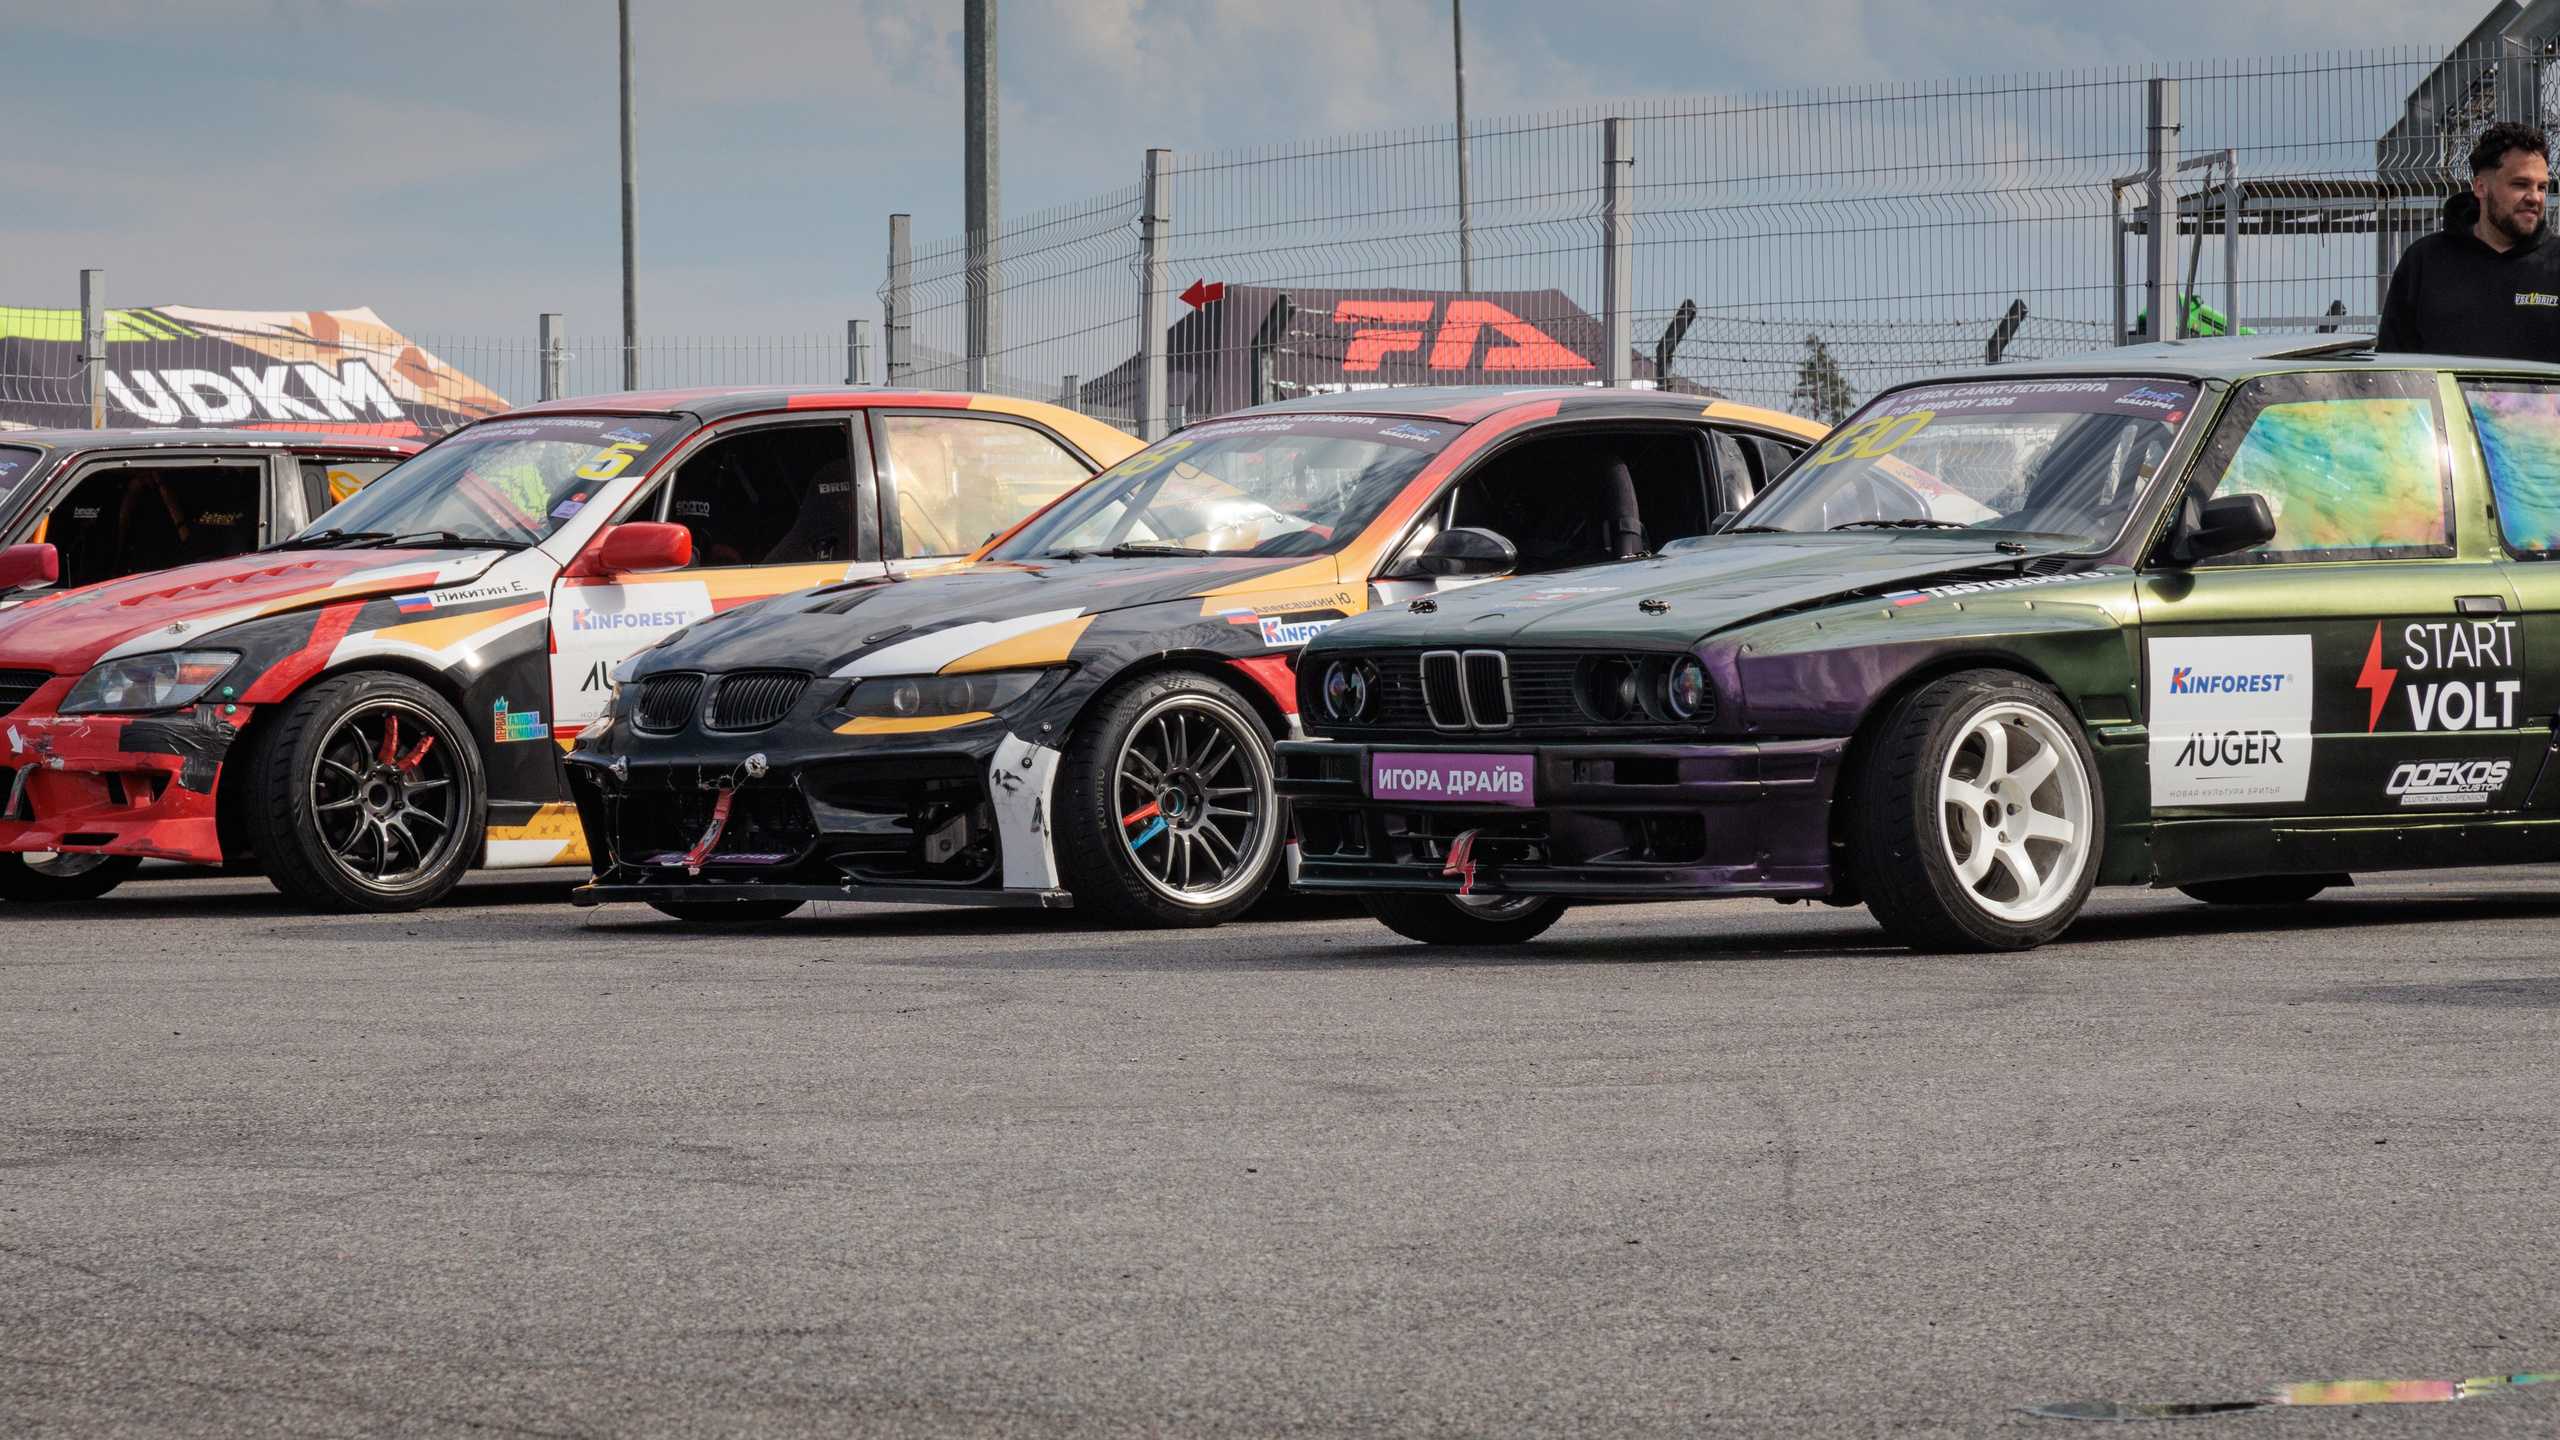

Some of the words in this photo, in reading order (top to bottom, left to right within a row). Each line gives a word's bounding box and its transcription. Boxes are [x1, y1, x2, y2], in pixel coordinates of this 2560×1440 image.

[1900, 388, 1954, 404] КУБОК
[1953, 382, 2109, 398] САНКТ-ПЕТЕРБУРГА
[2114, 397, 2176, 410] МАЦУРИ
[1887, 405, 1912, 417] ПО
[1909, 398, 1979, 415] ДРИФТУ
[1976, 396, 2017, 407] 2026
[576, 442, 650, 481] 5
[676, 501, 710, 517] sparco
[1252, 597, 1336, 614] Алексашкин
[1335, 591, 1356, 605] Ю.
[572, 608, 686, 631] KINFOREST
[2404, 621, 2517, 671] START
[2169, 666, 2286, 694] KINFOREST
[2406, 680, 2521, 731] VOLT
[495, 711, 507, 741] ПЕРВАЯ
[507, 712, 539, 727] ГАЗОВАЯ
[508, 725, 548, 740] КОМПАНИЯ
[2174, 730, 2284, 767] AUGER
[1378, 768, 1443, 791] ИГОРА
[1446, 765, 1524, 796] ДРАЙВ
[2169, 789, 2199, 798] НОВАЯ
[2201, 787, 2245, 797] КУЛЬТУРА
[2247, 786, 2281, 795] БРИТЬЯ
[2458, 783, 2503, 792] CUSTOM
[1096, 767, 1108, 831] KUMHO
[2403, 795, 2429, 804] CLUTCH
[2431, 794, 2445, 803] AND
[2446, 793, 2487, 803] SUSPENSION
